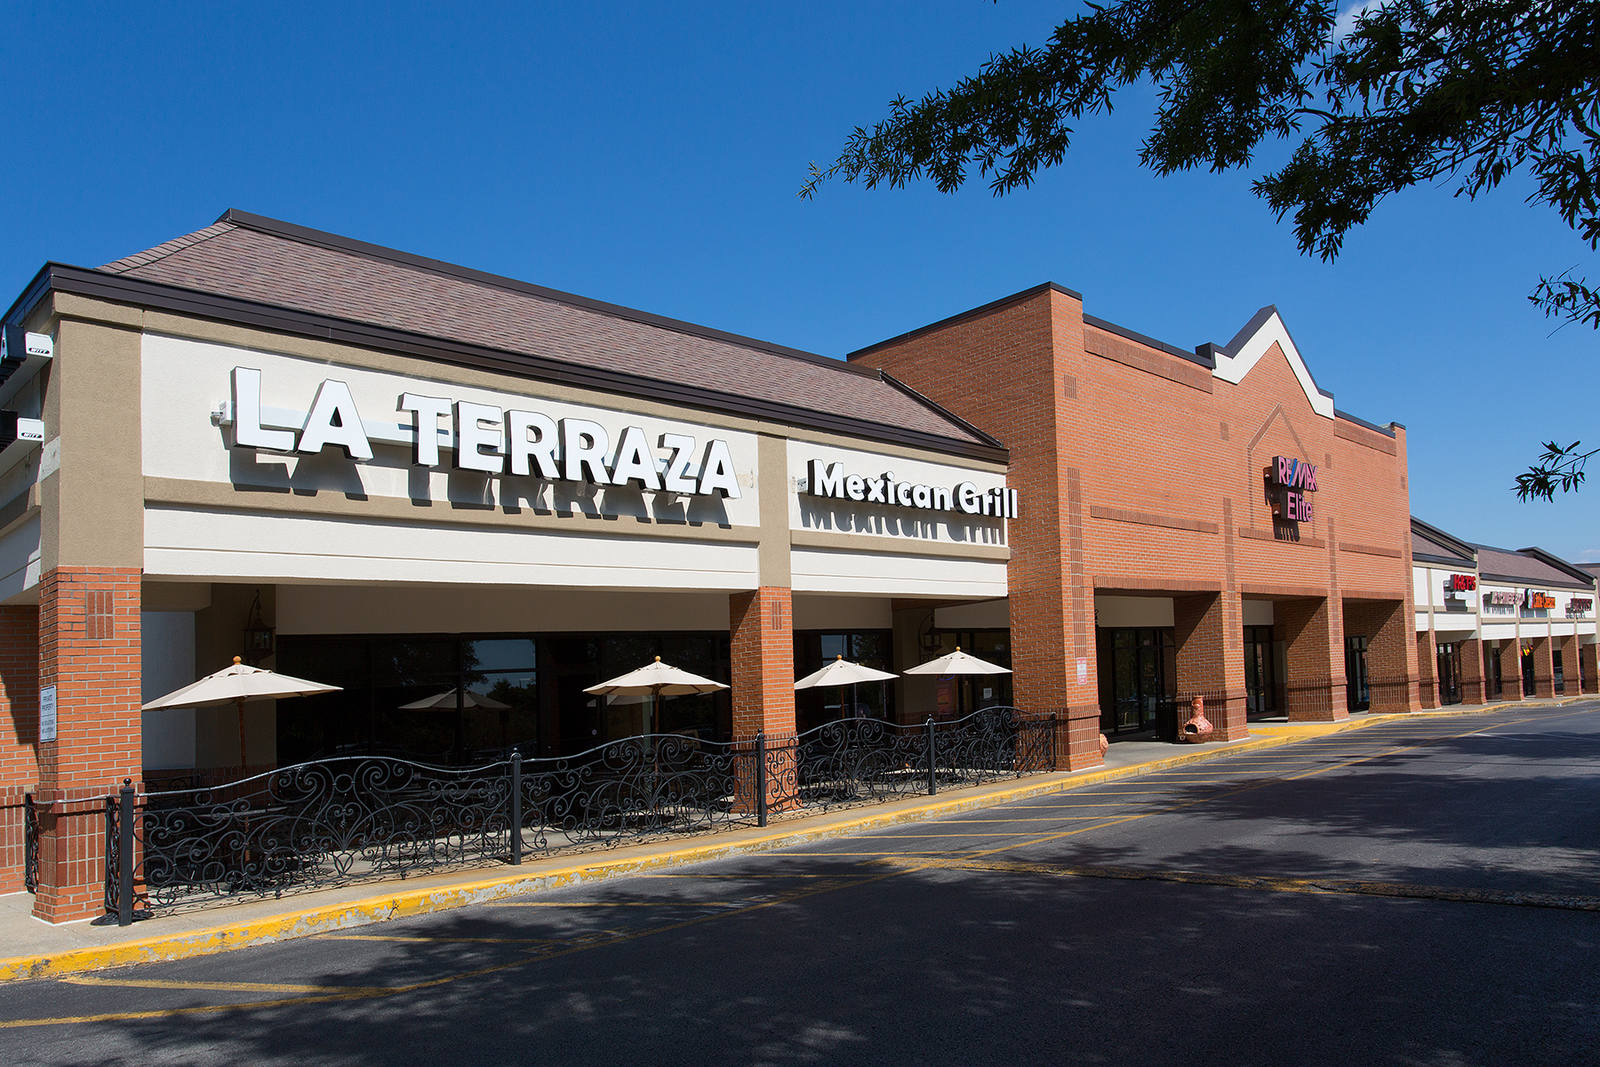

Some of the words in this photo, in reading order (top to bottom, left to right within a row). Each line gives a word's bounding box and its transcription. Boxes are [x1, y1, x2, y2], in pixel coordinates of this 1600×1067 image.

[231, 366, 374, 462] LA
[397, 392, 742, 499] TERRAZA
[809, 459, 951, 513] Mexican
[954, 481, 1018, 519] Grill
[1277, 456, 1319, 492] RE/MAX
[1287, 491, 1313, 522] Elite
